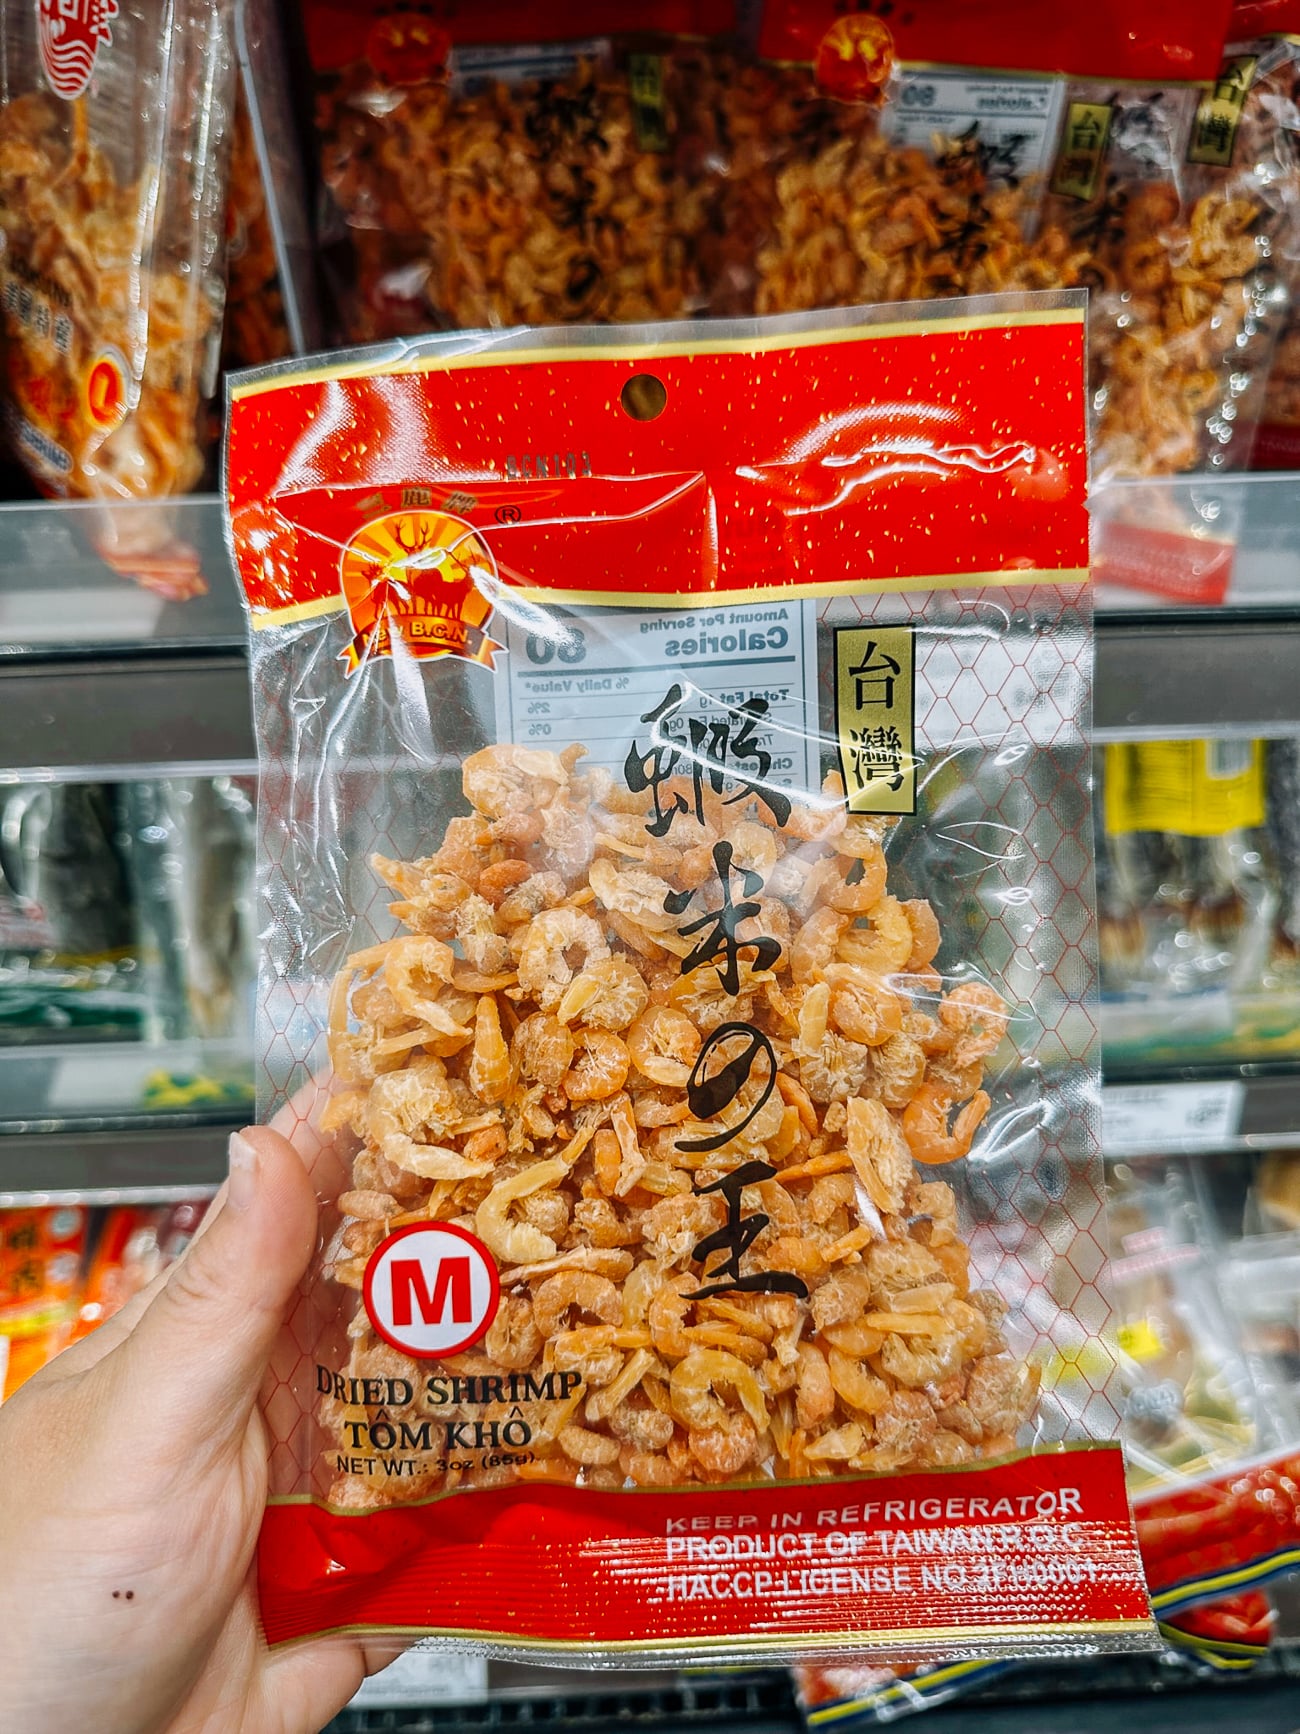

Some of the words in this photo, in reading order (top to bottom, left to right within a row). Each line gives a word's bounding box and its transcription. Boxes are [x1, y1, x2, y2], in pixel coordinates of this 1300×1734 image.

[848, 640, 905, 792] 台灣
[390, 1256, 473, 1327] M
[316, 1365, 413, 1406] DRIED
[426, 1371, 583, 1406] SHRIMP
[344, 1408, 433, 1451] TÔM
[446, 1408, 532, 1449] KHÔ
[336, 1454, 377, 1475] NET
[436, 1459, 476, 1472] 3oz
[481, 1451, 536, 1469] (85g)
[666, 1514, 759, 1534] KEEP
[770, 1511, 804, 1530] IN
[817, 1486, 1085, 1527] REFRIGERATOR
[665, 1532, 818, 1563] PRODUCT
[825, 1531, 867, 1557] OF
